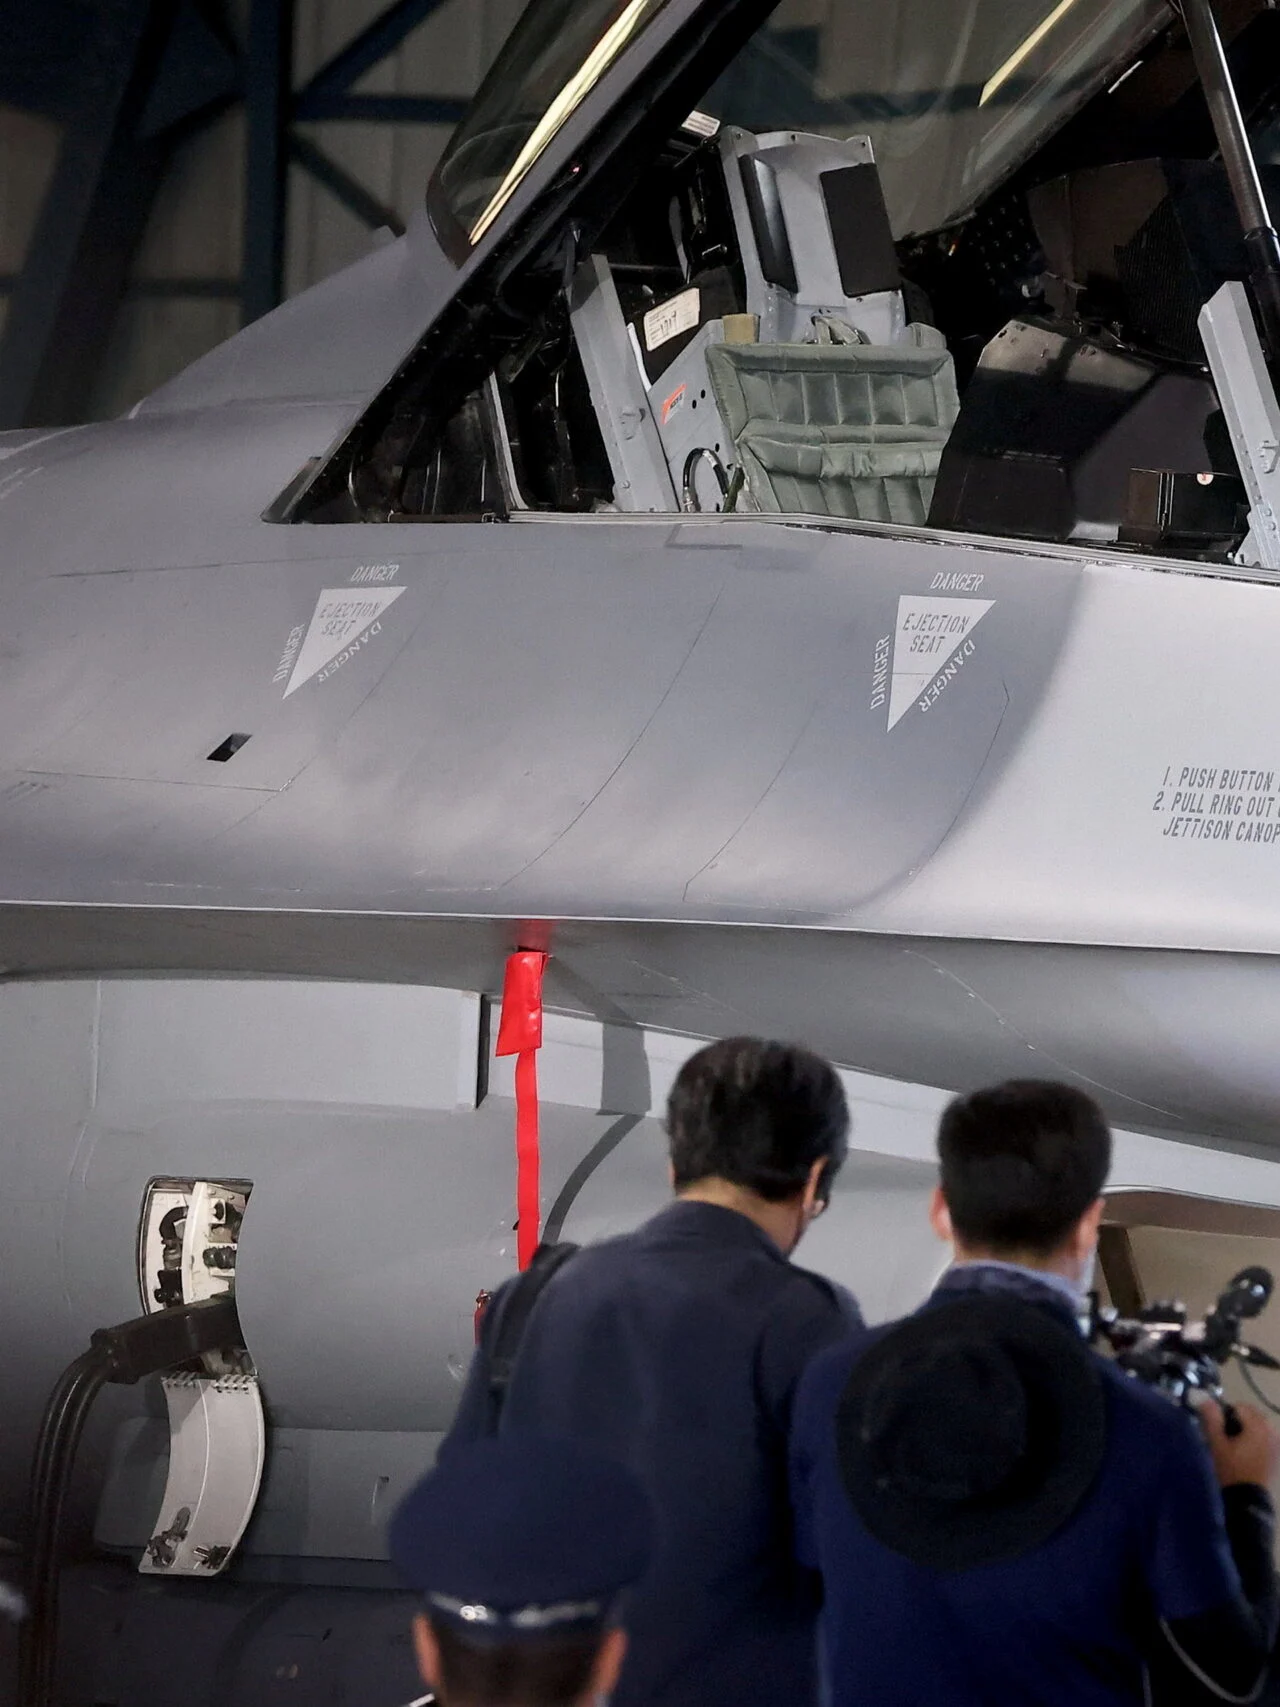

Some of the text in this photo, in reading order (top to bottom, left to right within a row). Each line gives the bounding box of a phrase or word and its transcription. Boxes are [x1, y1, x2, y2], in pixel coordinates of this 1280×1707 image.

[351, 564, 399, 582] DANGER
[930, 572, 984, 591] DANGER
[319, 601, 381, 618] EJECTION
[322, 620, 356, 636] SEAT
[902, 613, 970, 633] EJECTION
[272, 623, 305, 683] DANGER
[318, 621, 382, 682] DANGER
[909, 635, 946, 653] SEAT
[870, 634, 890, 710] DANGER
[918, 639, 976, 712] DANGER
[1162, 766, 1173, 787] 1.
[1178, 767, 1219, 789] PUSH
[1219, 769, 1274, 792] BUTTON
[1152, 791, 1165, 812] 2.
[1171, 792, 1205, 814] PULL
[1209, 794, 1243, 816] RING
[1246, 797, 1275, 818] OUT
[1163, 816, 1232, 840] JETTISON
